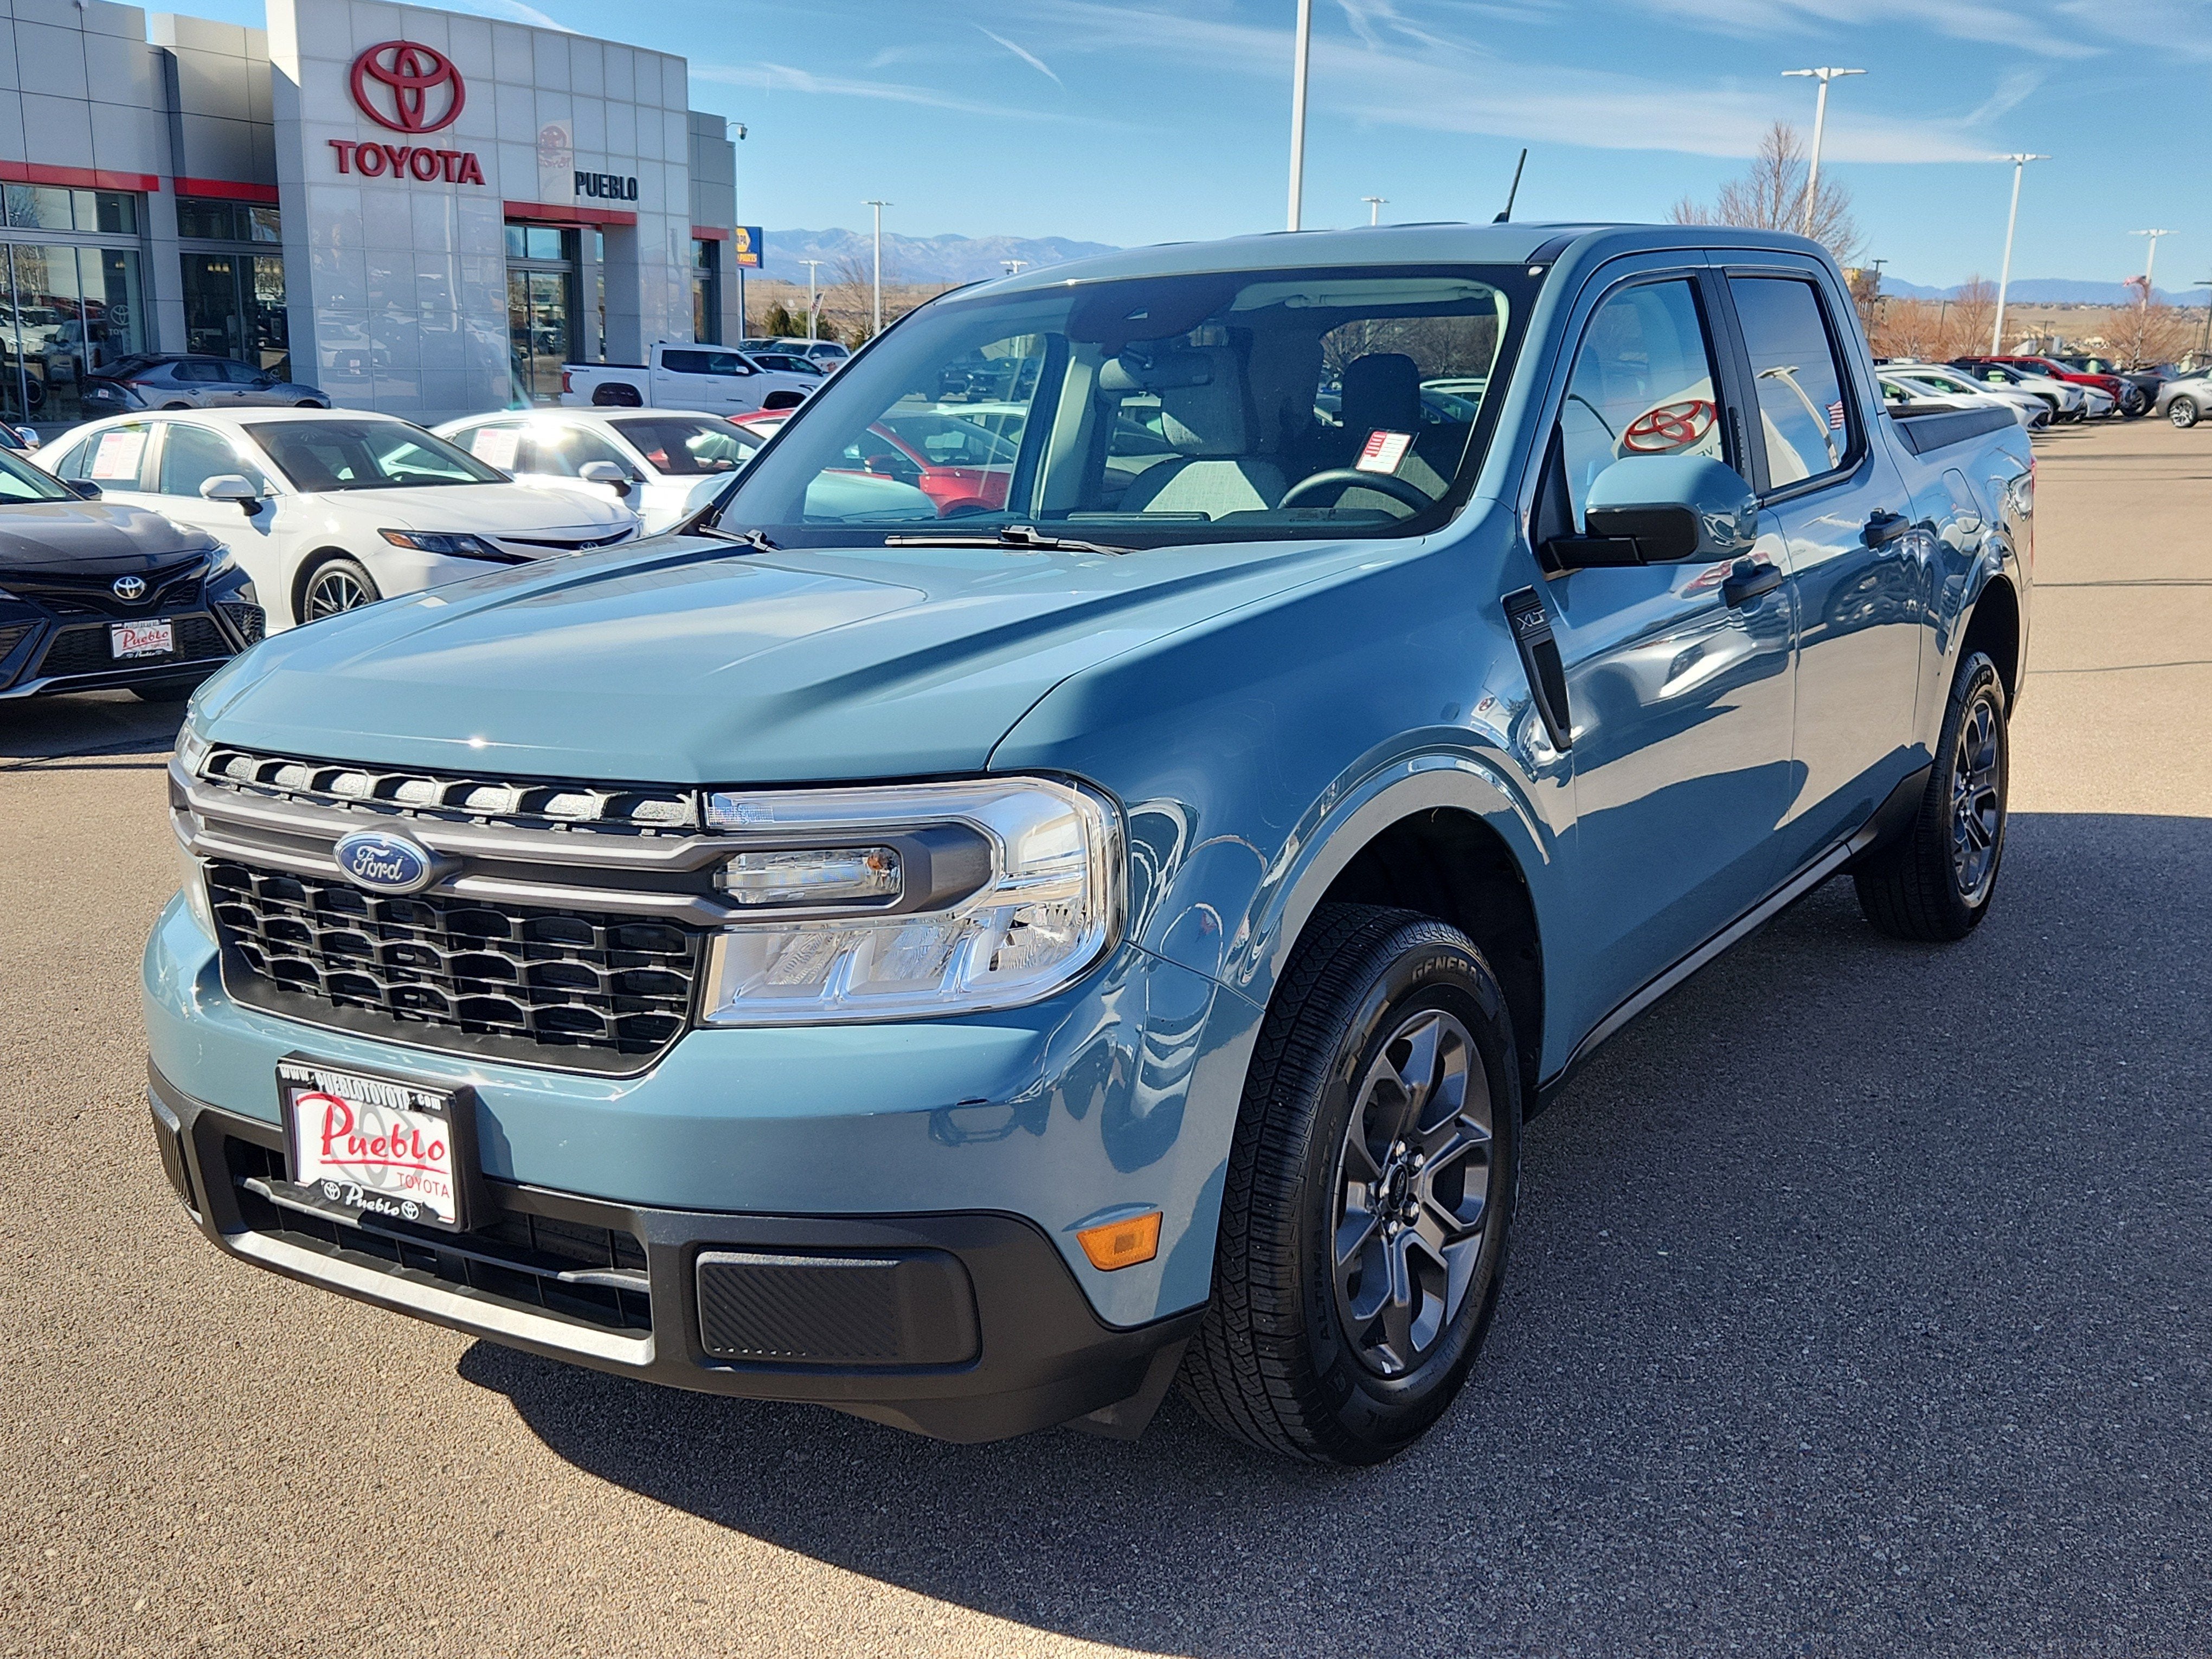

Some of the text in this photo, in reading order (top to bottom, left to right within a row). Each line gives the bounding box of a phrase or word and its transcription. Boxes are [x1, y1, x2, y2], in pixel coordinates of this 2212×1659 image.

[329, 139, 486, 185] TOYOTA
[575, 171, 638, 201] PUEBLO
[1516, 608, 1545, 631] XLT
[113, 629, 168, 648] Pueblo
[353, 845, 403, 880] Ford
[1412, 955, 1484, 993] GENERAL
[295, 1091, 445, 1161] Pueblo
[338, 1180, 400, 1216] Pueblo
[397, 1172, 450, 1199] TOYOTA
